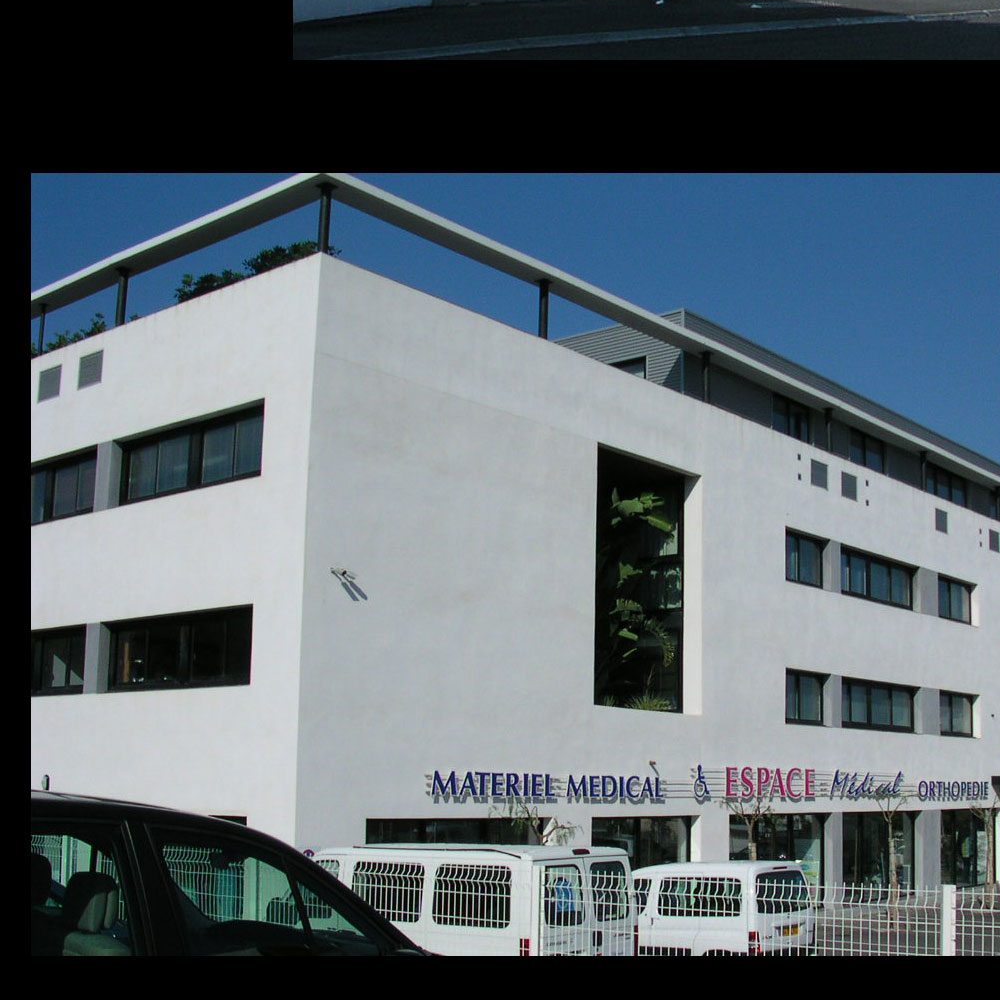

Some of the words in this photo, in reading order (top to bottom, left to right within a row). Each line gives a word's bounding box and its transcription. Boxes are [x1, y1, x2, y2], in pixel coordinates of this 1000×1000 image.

[431, 770, 555, 797] MATERIEL
[566, 774, 664, 798] MEDICAL
[725, 766, 816, 798] ESPACE
[829, 769, 903, 800] Médical
[917, 780, 989, 799] ORTHOPEDIE
